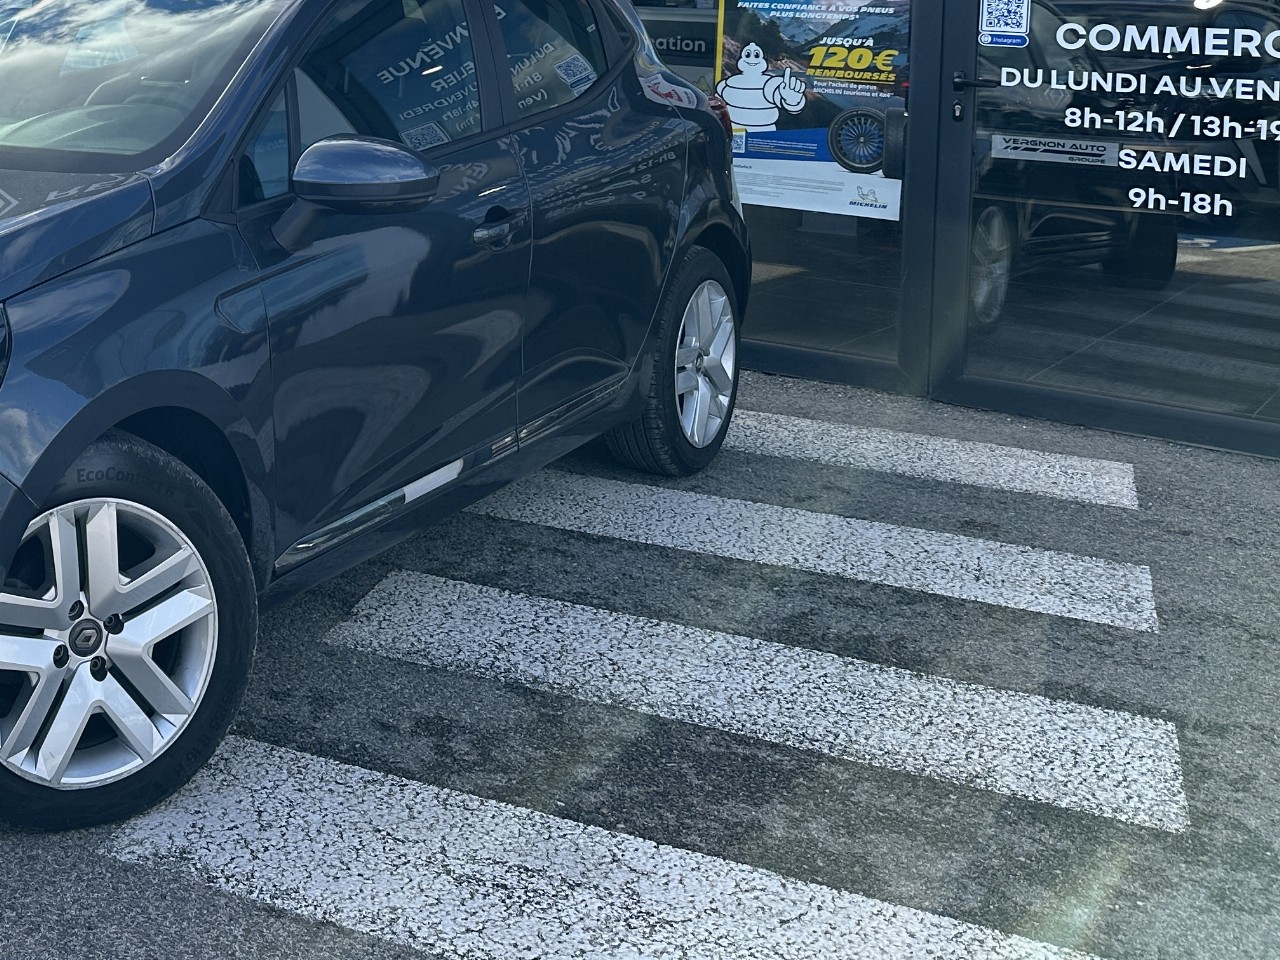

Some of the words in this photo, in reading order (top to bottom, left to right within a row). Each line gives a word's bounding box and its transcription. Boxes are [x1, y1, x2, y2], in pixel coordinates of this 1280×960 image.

[737, 1, 769, 9] FAITES
[771, 3, 827, 11] CONFIANCE
[809, 46, 899, 71] 120€
[806, 68, 896, 81] REMBOURSÉS
[1000, 67, 1043, 88] DU
[1050, 70, 1146, 94] LUNDI
[1153, 75, 1201, 97] AU
[1209, 77, 1280, 101] VEN
[1064, 107, 1164, 134] 8h-12h
[1168, 113, 1186, 138] /
[1002, 137, 1066, 149] VERGNON
[1070, 143, 1106, 153] AUTO
[1068, 157, 1105, 165] GROUPE
[1118, 149, 1246, 178] SAMEDI
[849, 201, 888, 209] MICHELIN
[1128, 188, 1233, 217] 9h-18h
